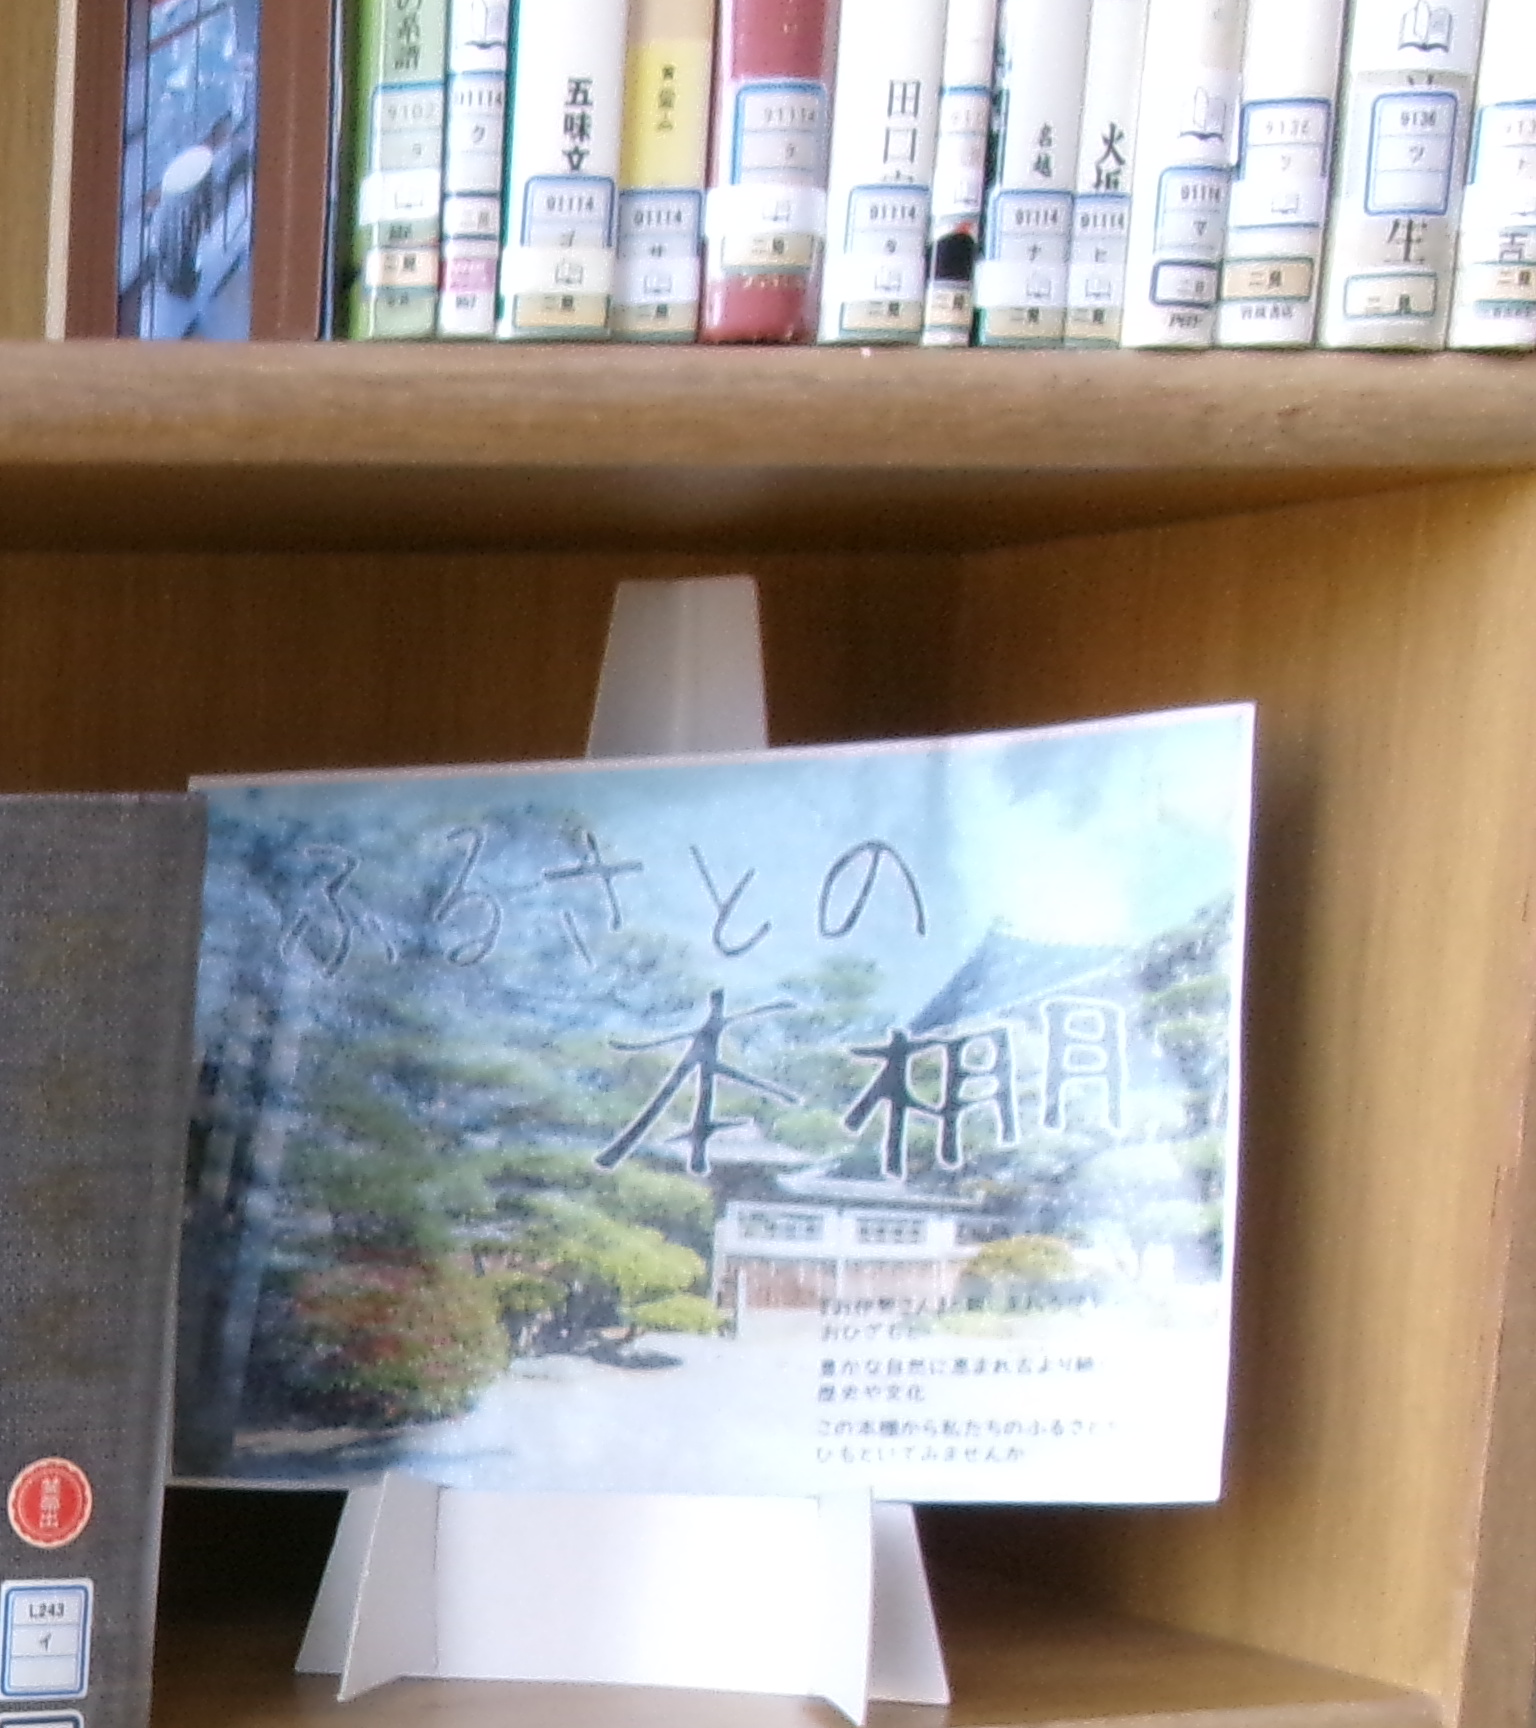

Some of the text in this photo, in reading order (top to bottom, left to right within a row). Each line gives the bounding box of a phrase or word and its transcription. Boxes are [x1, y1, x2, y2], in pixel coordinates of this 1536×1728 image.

[277, 825, 930, 978] ふるさとの
[28, 1601, 67, 1620] L243
